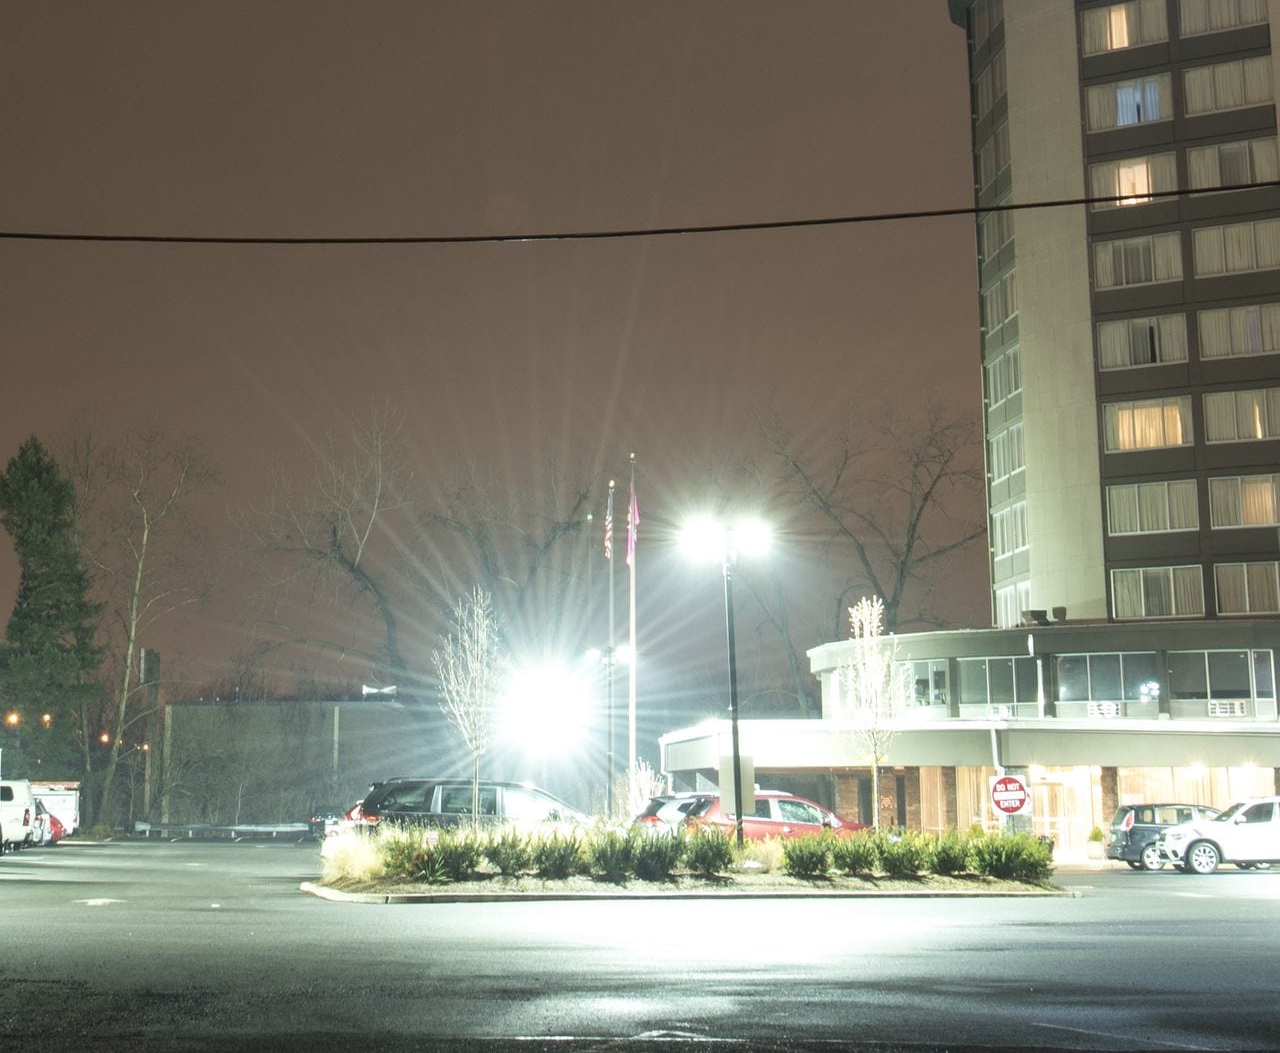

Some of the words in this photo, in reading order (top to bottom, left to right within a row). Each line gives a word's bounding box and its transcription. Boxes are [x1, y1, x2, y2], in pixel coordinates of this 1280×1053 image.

[996, 783, 1006, 791] DO
[1007, 783, 1020, 791] NOT
[1000, 800, 1020, 808] ENTER
